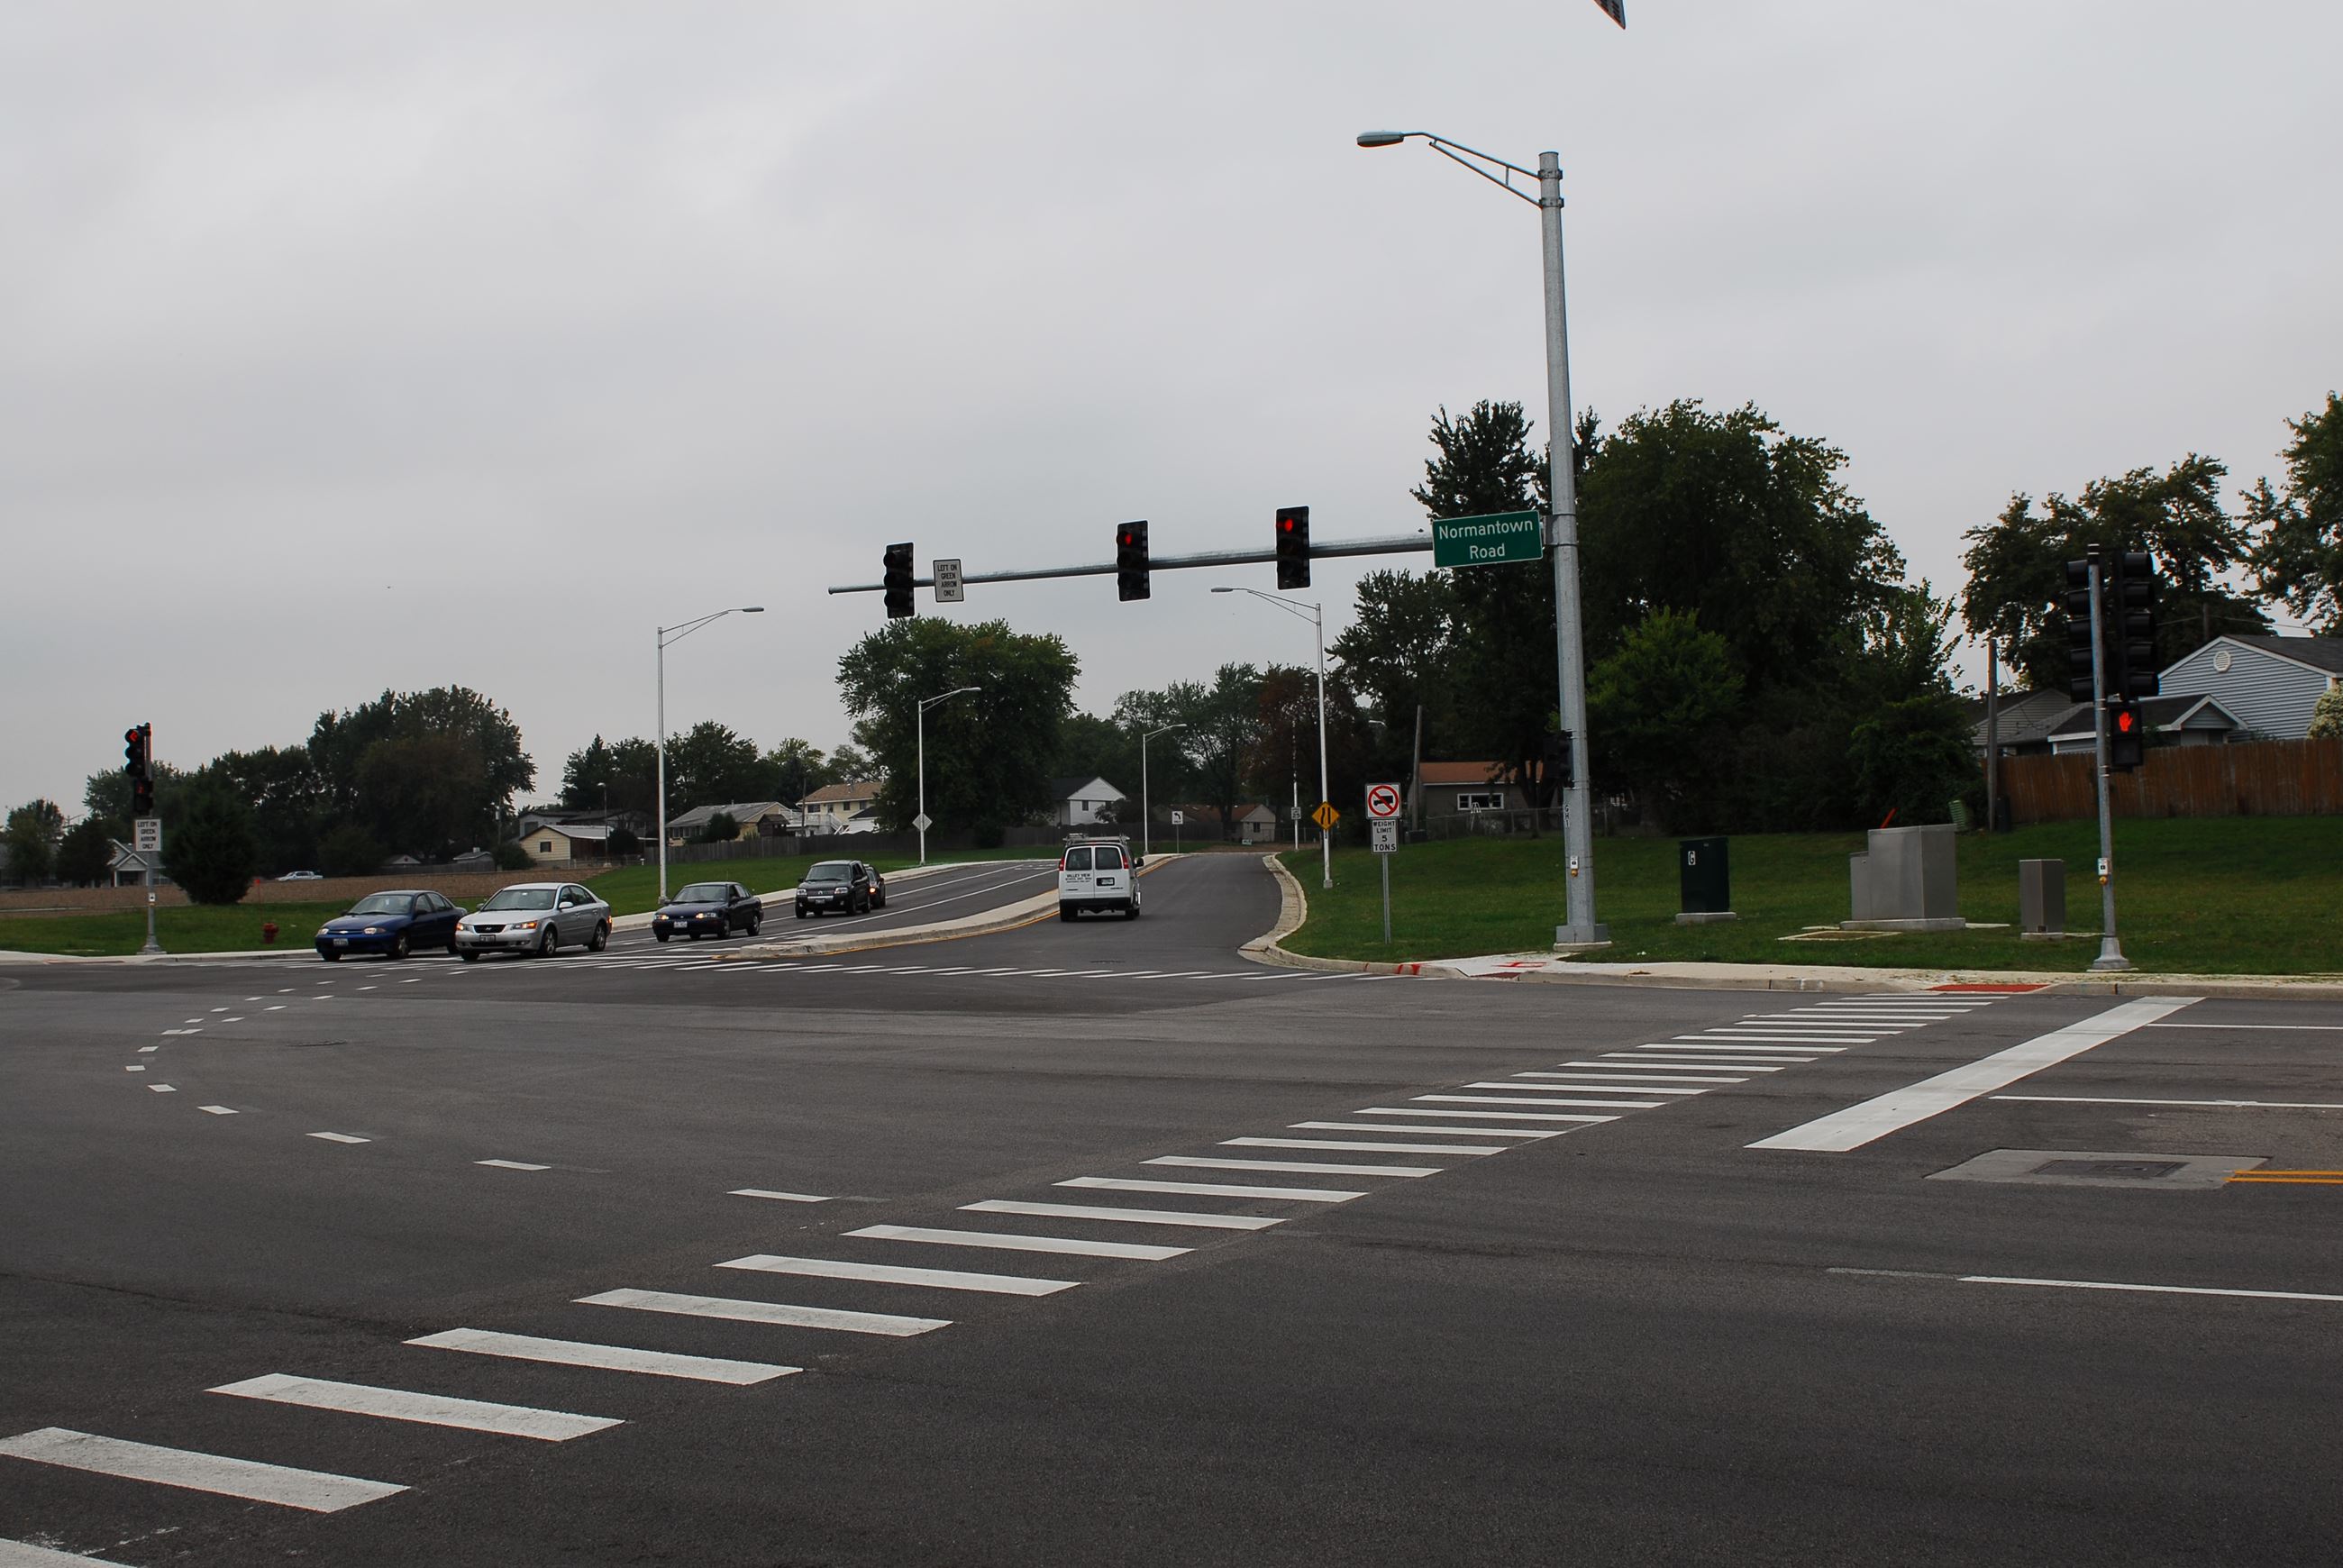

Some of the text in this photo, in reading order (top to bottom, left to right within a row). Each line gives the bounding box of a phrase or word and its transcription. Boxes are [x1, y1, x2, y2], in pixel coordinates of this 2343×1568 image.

[1439, 520, 1533, 540] Normantown
[1469, 542, 1505, 559] Road
[1689, 852, 1695, 864] G
